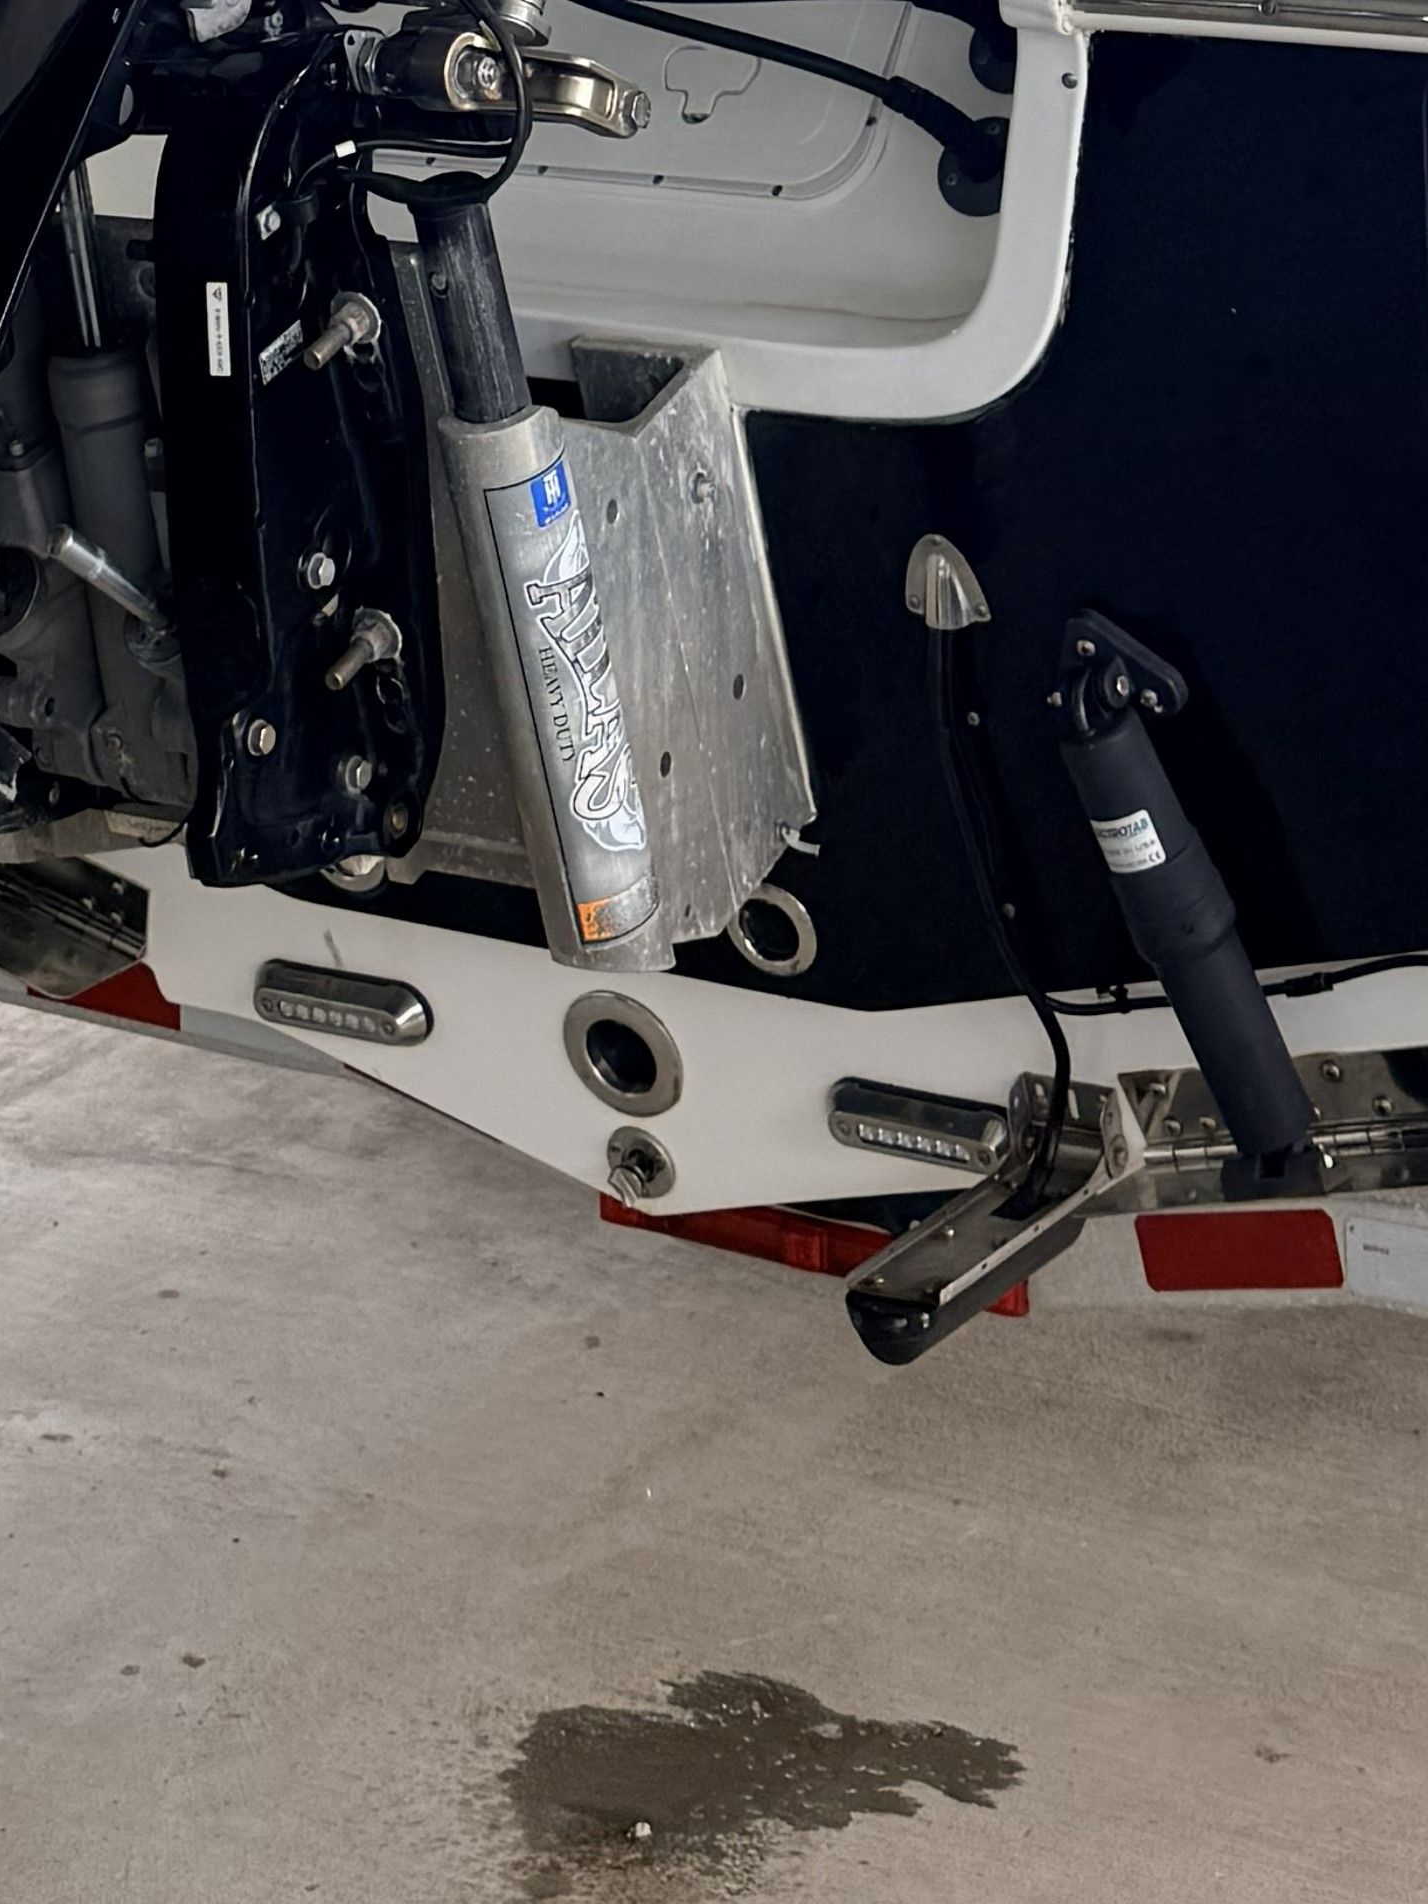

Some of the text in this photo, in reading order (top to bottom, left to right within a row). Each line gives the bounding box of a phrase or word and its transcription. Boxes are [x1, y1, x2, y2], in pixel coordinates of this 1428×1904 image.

[526, 568, 632, 824] ATLAS
[538, 646, 577, 766] HEAVY DUTY
